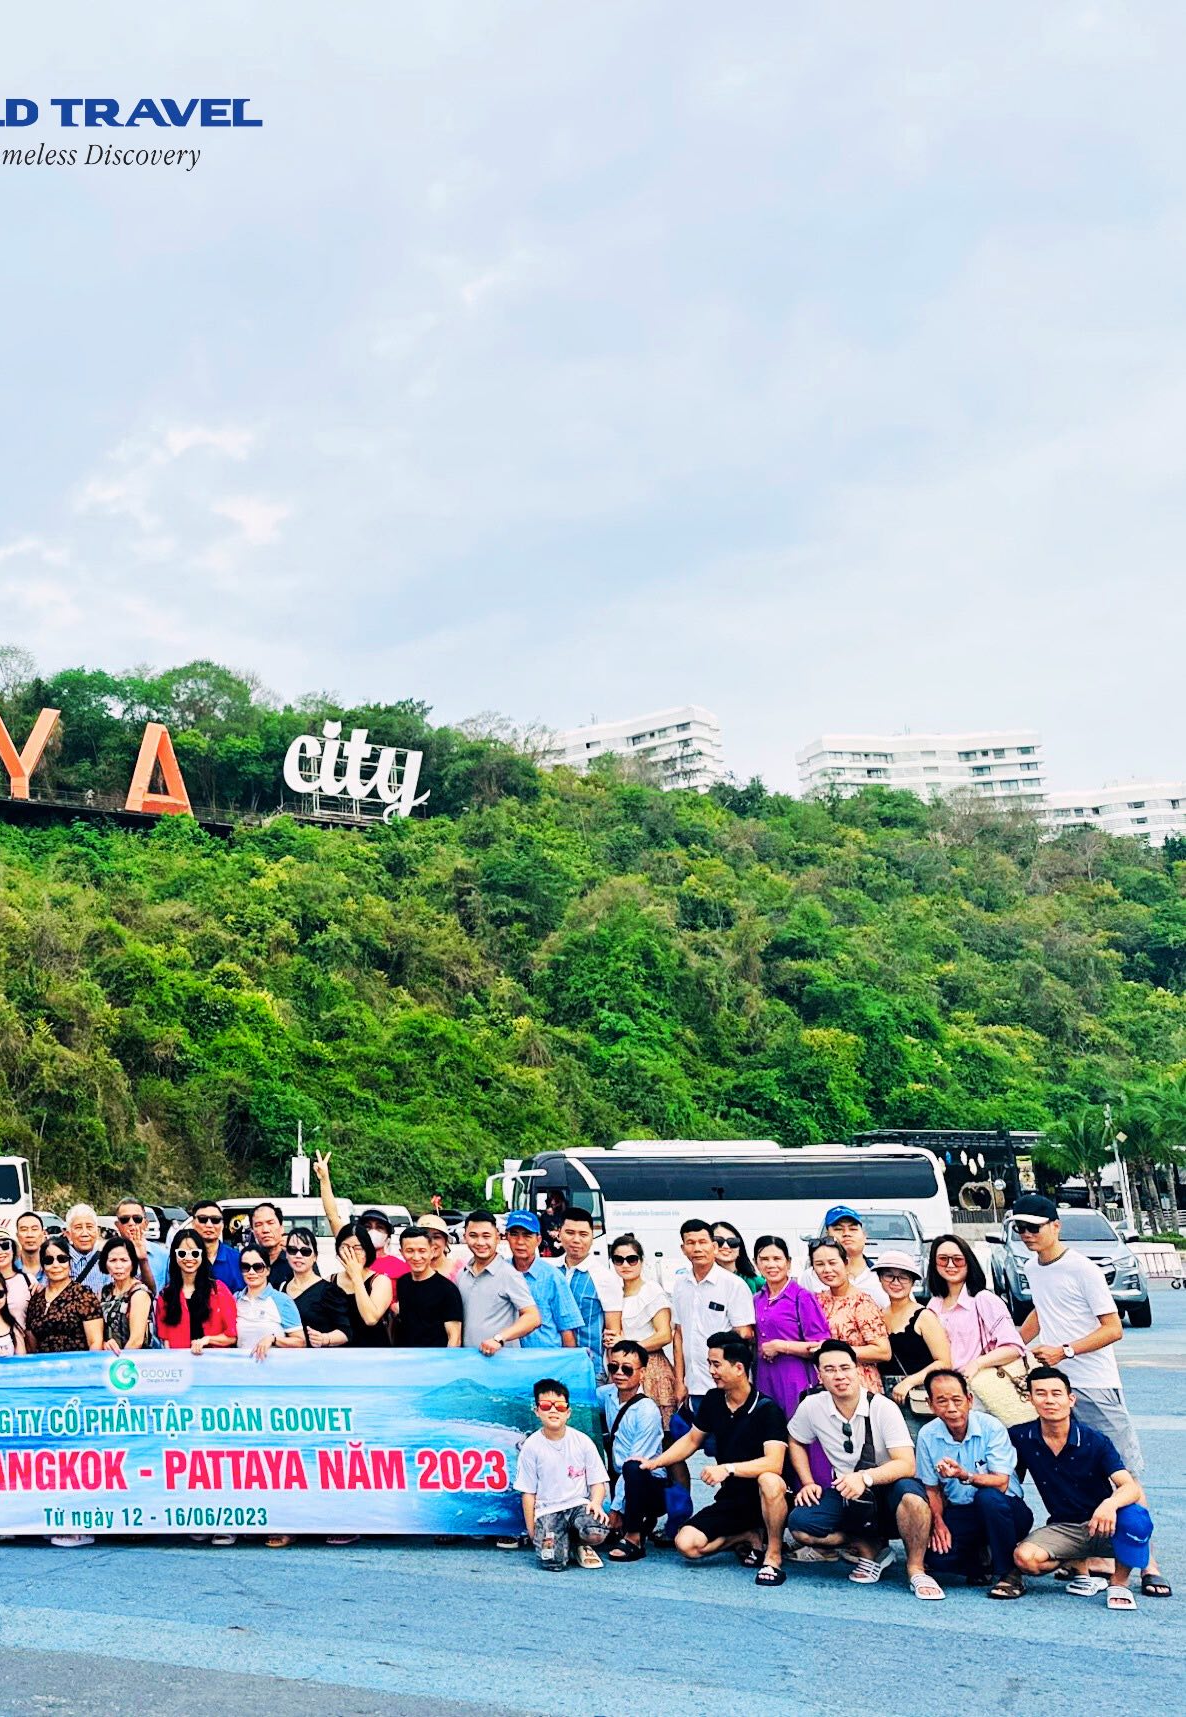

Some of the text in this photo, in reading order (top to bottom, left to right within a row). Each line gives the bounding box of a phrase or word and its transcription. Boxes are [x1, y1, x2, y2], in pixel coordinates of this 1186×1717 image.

[283, 719, 431, 824] city
[141, 1368, 184, 1378] GOOVET
[17, 1409, 42, 1434] TY
[50, 1399, 79, 1434] CỔ
[85, 1400, 145, 1433] PHẦN
[152, 1403, 193, 1437] TẬP
[201, 1402, 263, 1432] ĐOÀN
[270, 1407, 352, 1432] GOOVET
[140, 1469, 152, 1477] -
[165, 1450, 308, 1490] PATTAYA
[318, 1441, 406, 1490] NĂM
[417, 1450, 508, 1490] 2023
[44, 1507, 65, 1526] Từ
[72, 1507, 114, 1528] ngày
[122, 1507, 143, 1526] 12
[164, 1507, 268, 1526] 16/06/2023
